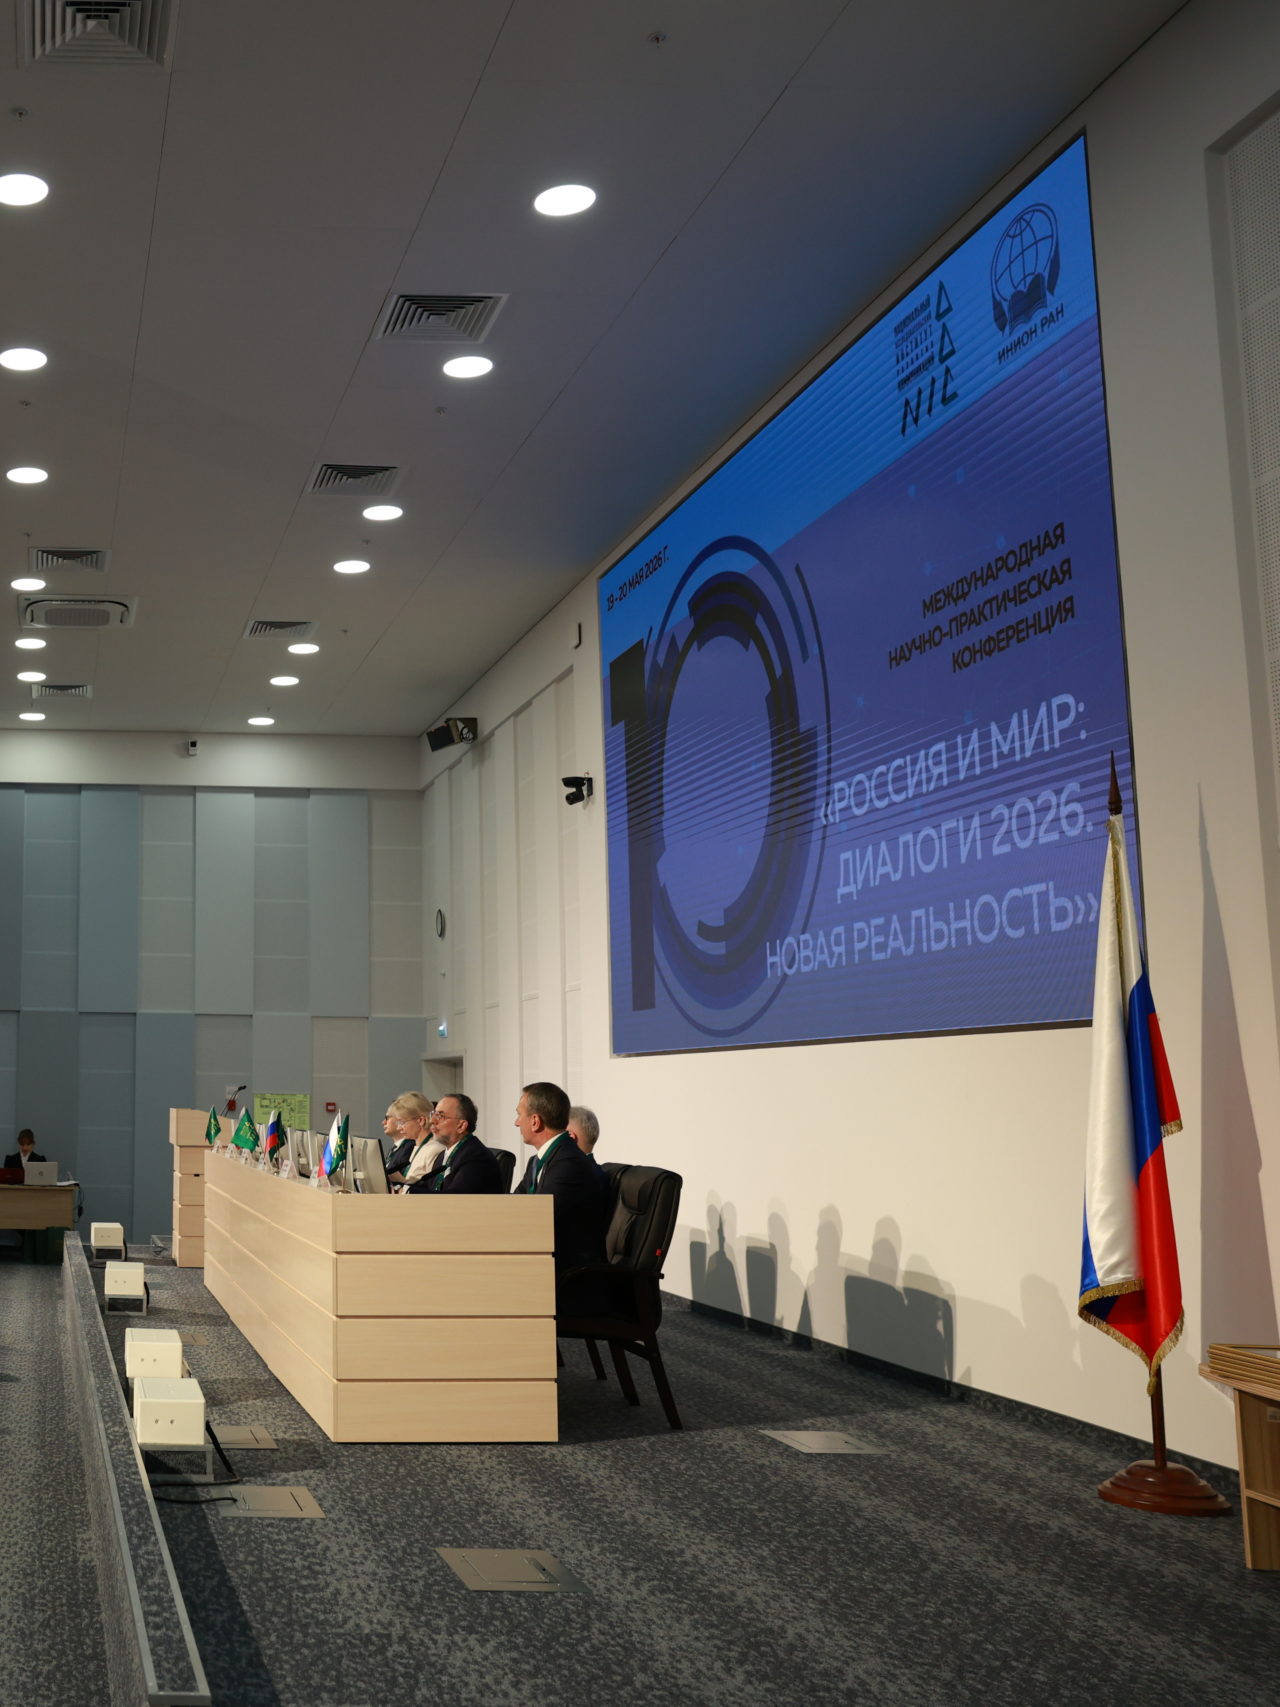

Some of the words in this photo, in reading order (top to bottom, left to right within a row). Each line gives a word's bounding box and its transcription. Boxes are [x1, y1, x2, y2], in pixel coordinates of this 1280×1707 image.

[997, 323, 1038, 365] ИНИОН
[1040, 303, 1065, 333] РАН
[628, 566, 645, 593] МАЯ
[888, 557, 1073, 670] НАУЧНО-ПРАКТИЧЕСКАЯ
[922, 521, 1066, 619] МЕЖДУНАРОДНАЯ
[951, 595, 1075, 673] КОНФЕРЕНЦИЯ
[819, 740, 949, 825] «РОССИЯ
[956, 727, 981, 781] И
[989, 693, 1088, 770] МИР:
[836, 811, 983, 905] ДИАЛОГИ
[990, 782, 1094, 856] 2026.
[766, 925, 847, 978] НОВАЯ
[853, 880, 1099, 965] РЕАЛЬНОСТЬ»
